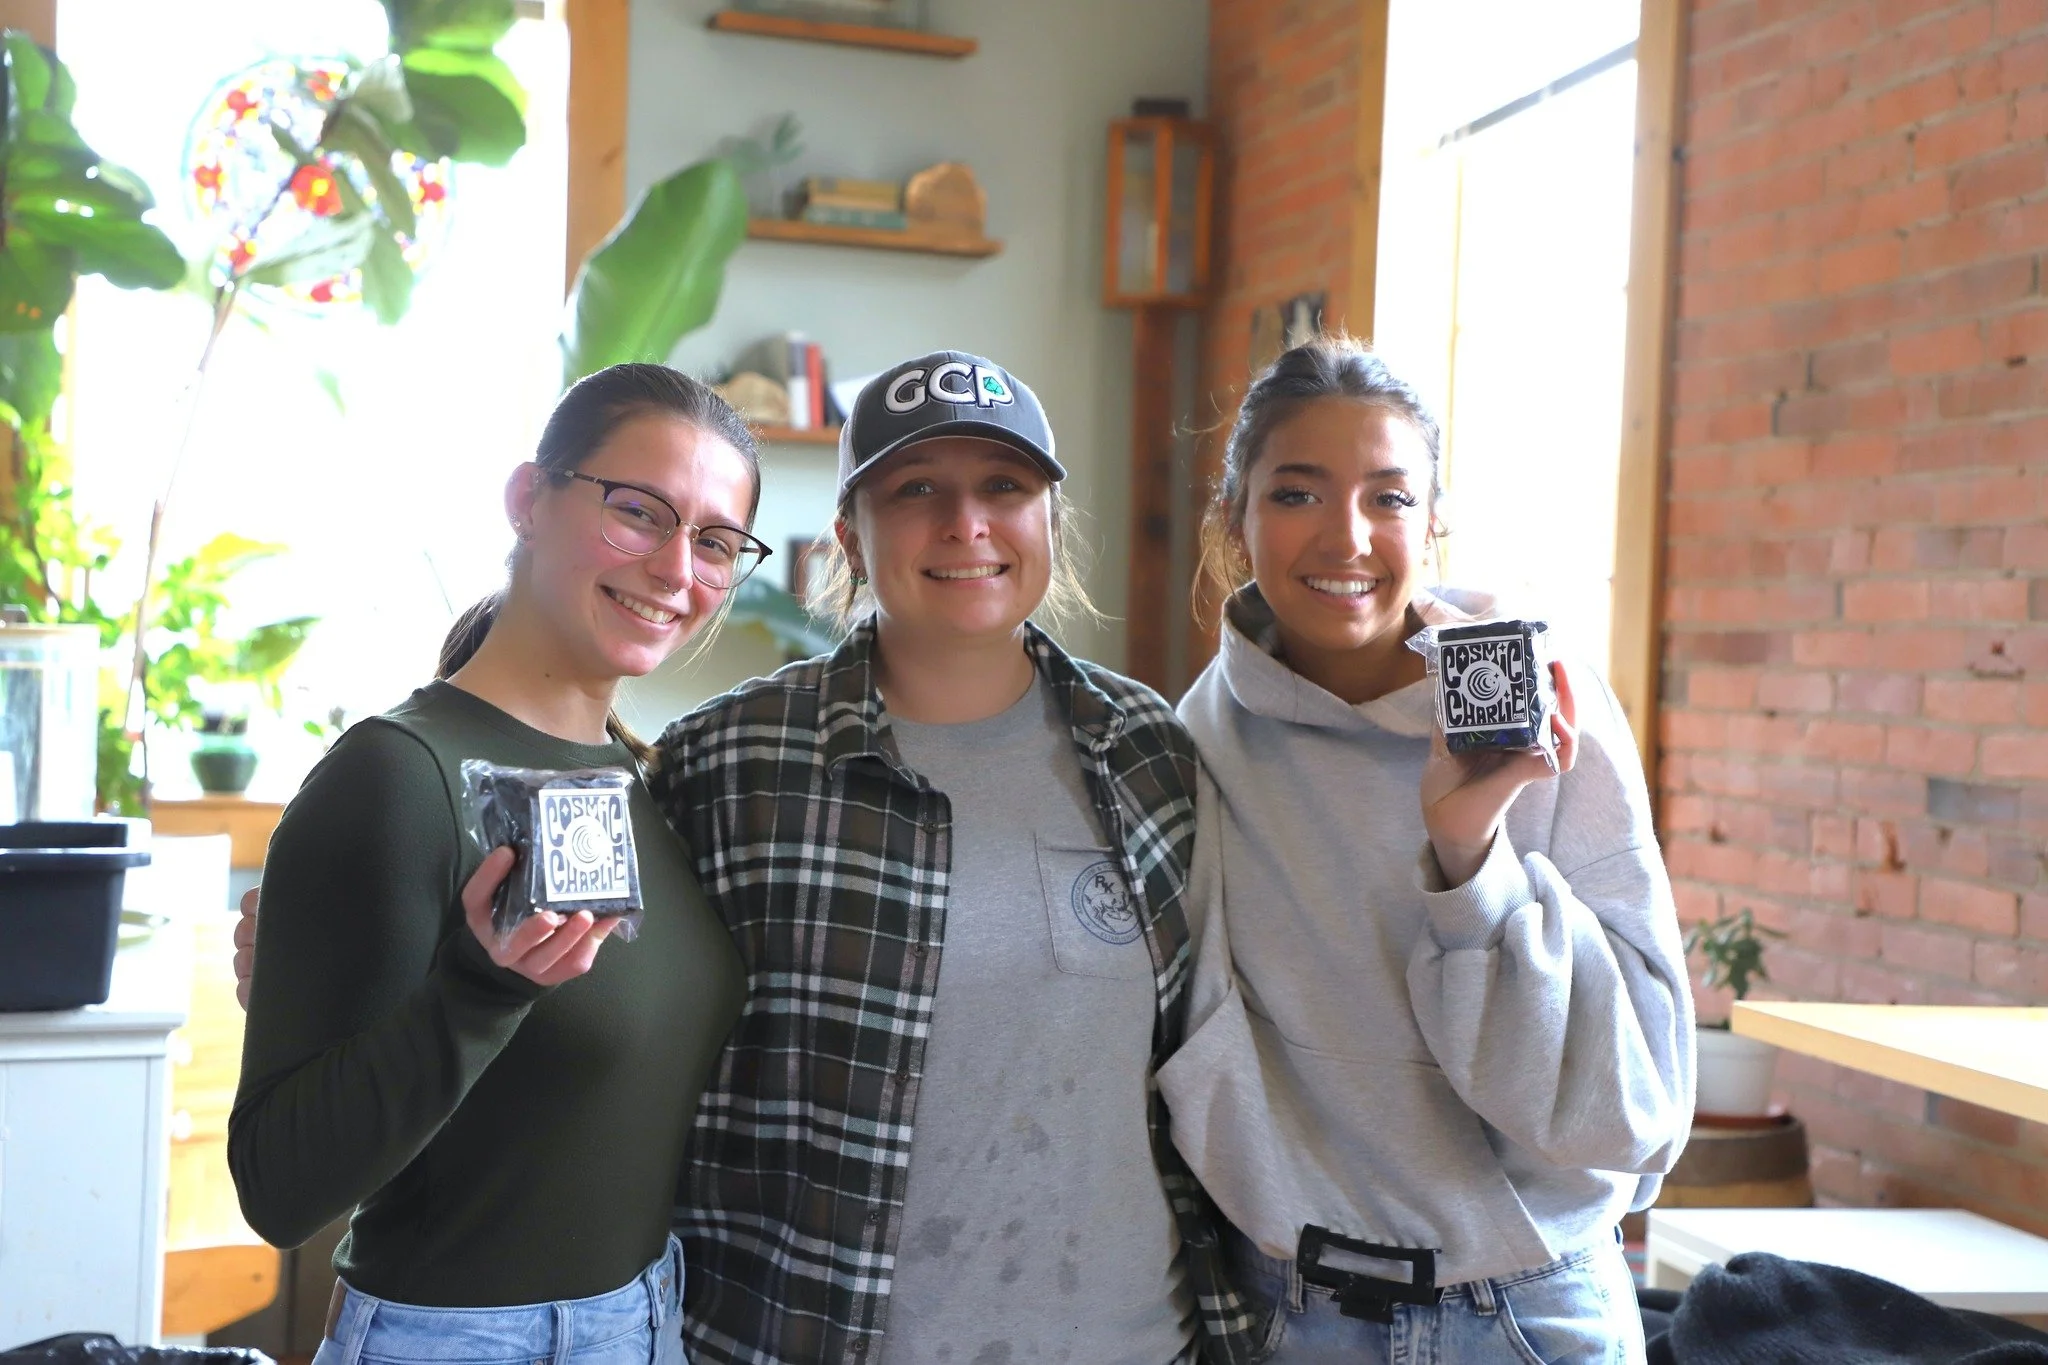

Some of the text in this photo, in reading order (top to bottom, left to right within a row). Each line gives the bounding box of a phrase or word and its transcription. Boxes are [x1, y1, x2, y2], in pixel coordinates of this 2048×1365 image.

[885, 361, 1014, 412] GCP
[1443, 641, 1523, 689] COSMIC
[1446, 683, 1525, 726] CHARLIE
[545, 795, 622, 847] COSMIC
[550, 844, 625, 893] CHARLIE
